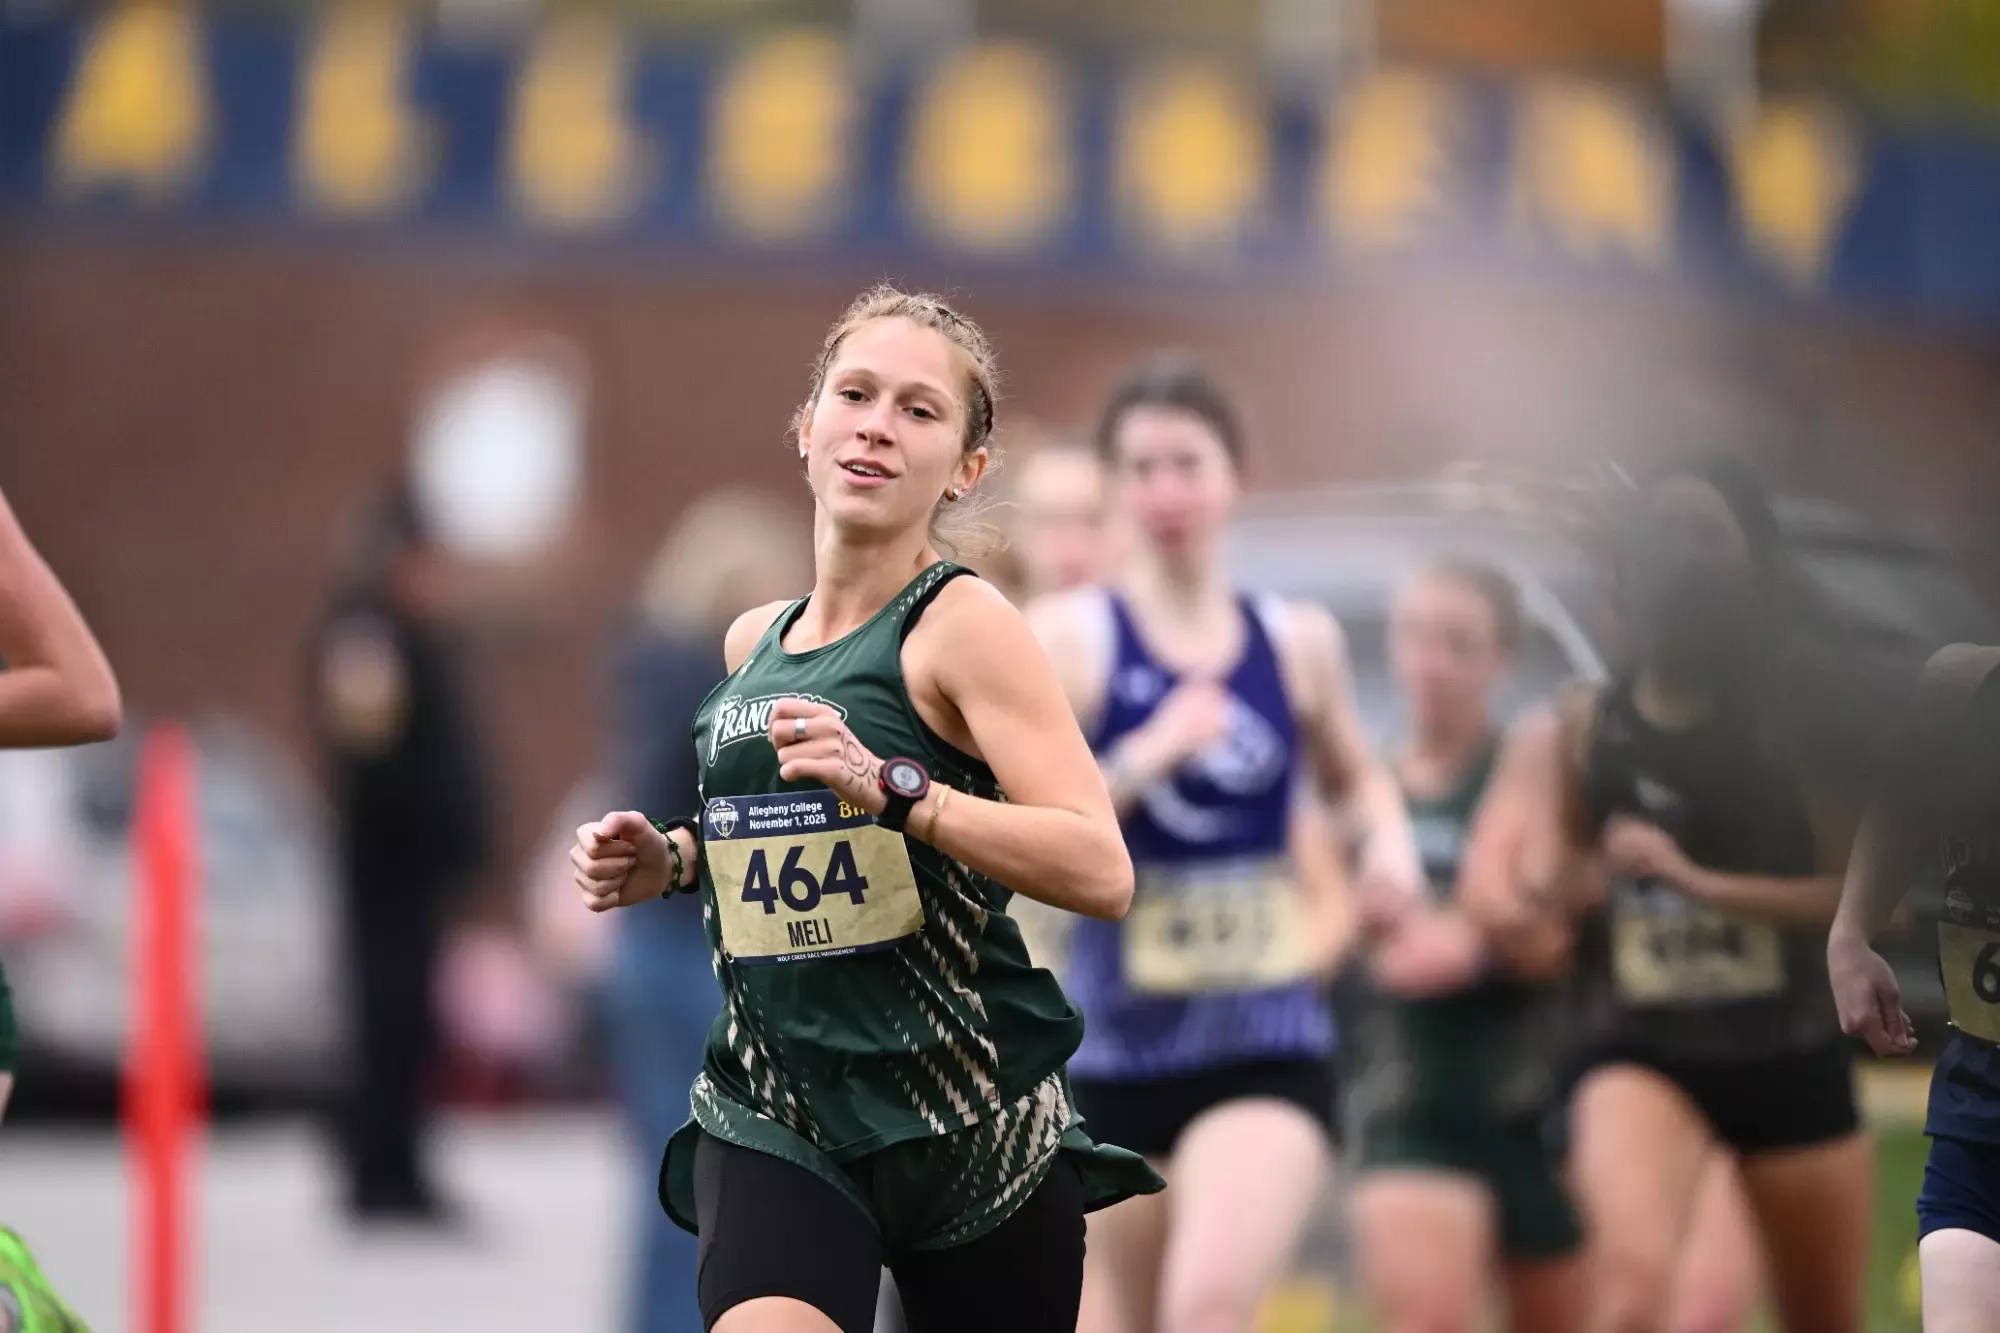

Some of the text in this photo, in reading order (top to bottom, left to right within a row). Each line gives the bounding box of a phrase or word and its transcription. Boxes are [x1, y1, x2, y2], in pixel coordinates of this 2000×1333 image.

[748, 803, 789, 817] Allegheny
[790, 801, 823, 814] College
[749, 817, 793, 830] November
[794, 816, 802, 827] 1,
[803, 813, 827, 825] 2025
[741, 840, 869, 915] 464
[787, 918, 833, 948] MELI
[776, 947, 856, 963] WOLF CREEK RACE MANAGEMENT
